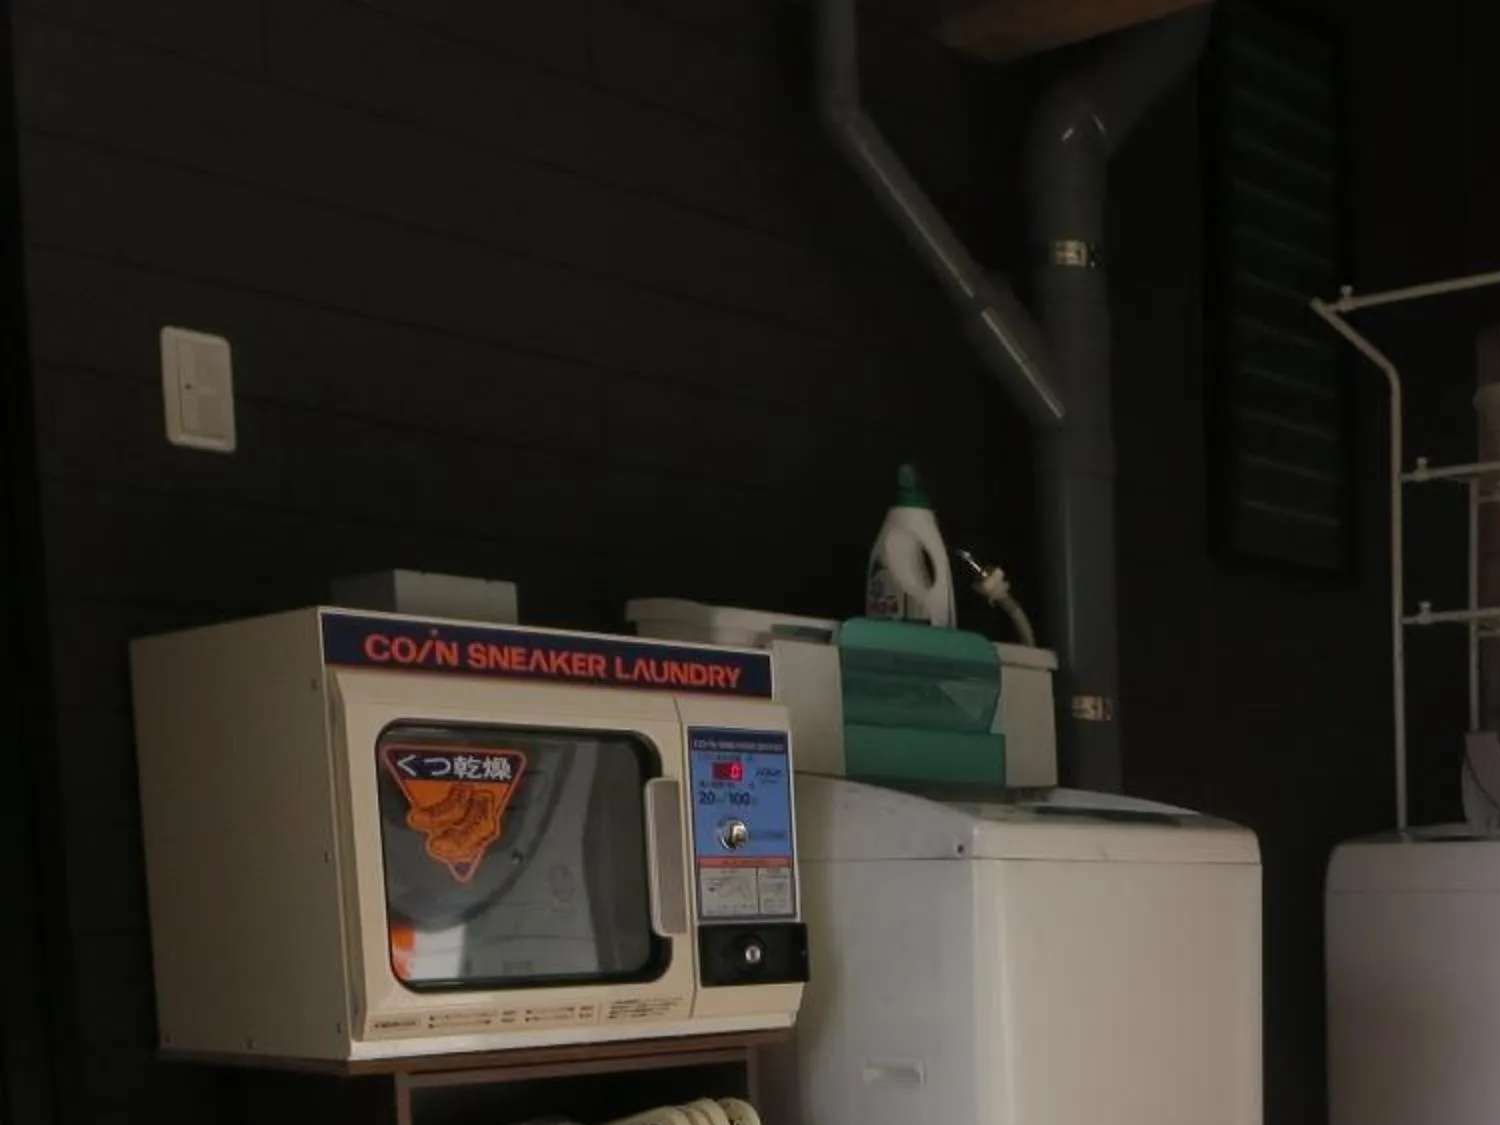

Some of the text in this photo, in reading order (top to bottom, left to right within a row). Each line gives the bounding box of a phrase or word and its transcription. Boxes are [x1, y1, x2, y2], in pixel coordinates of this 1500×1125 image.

[467, 642, 606, 678] SNEAKER
[616, 655, 742, 689] LAUNDRY
[397, 754, 512, 780] くつ乾燥
